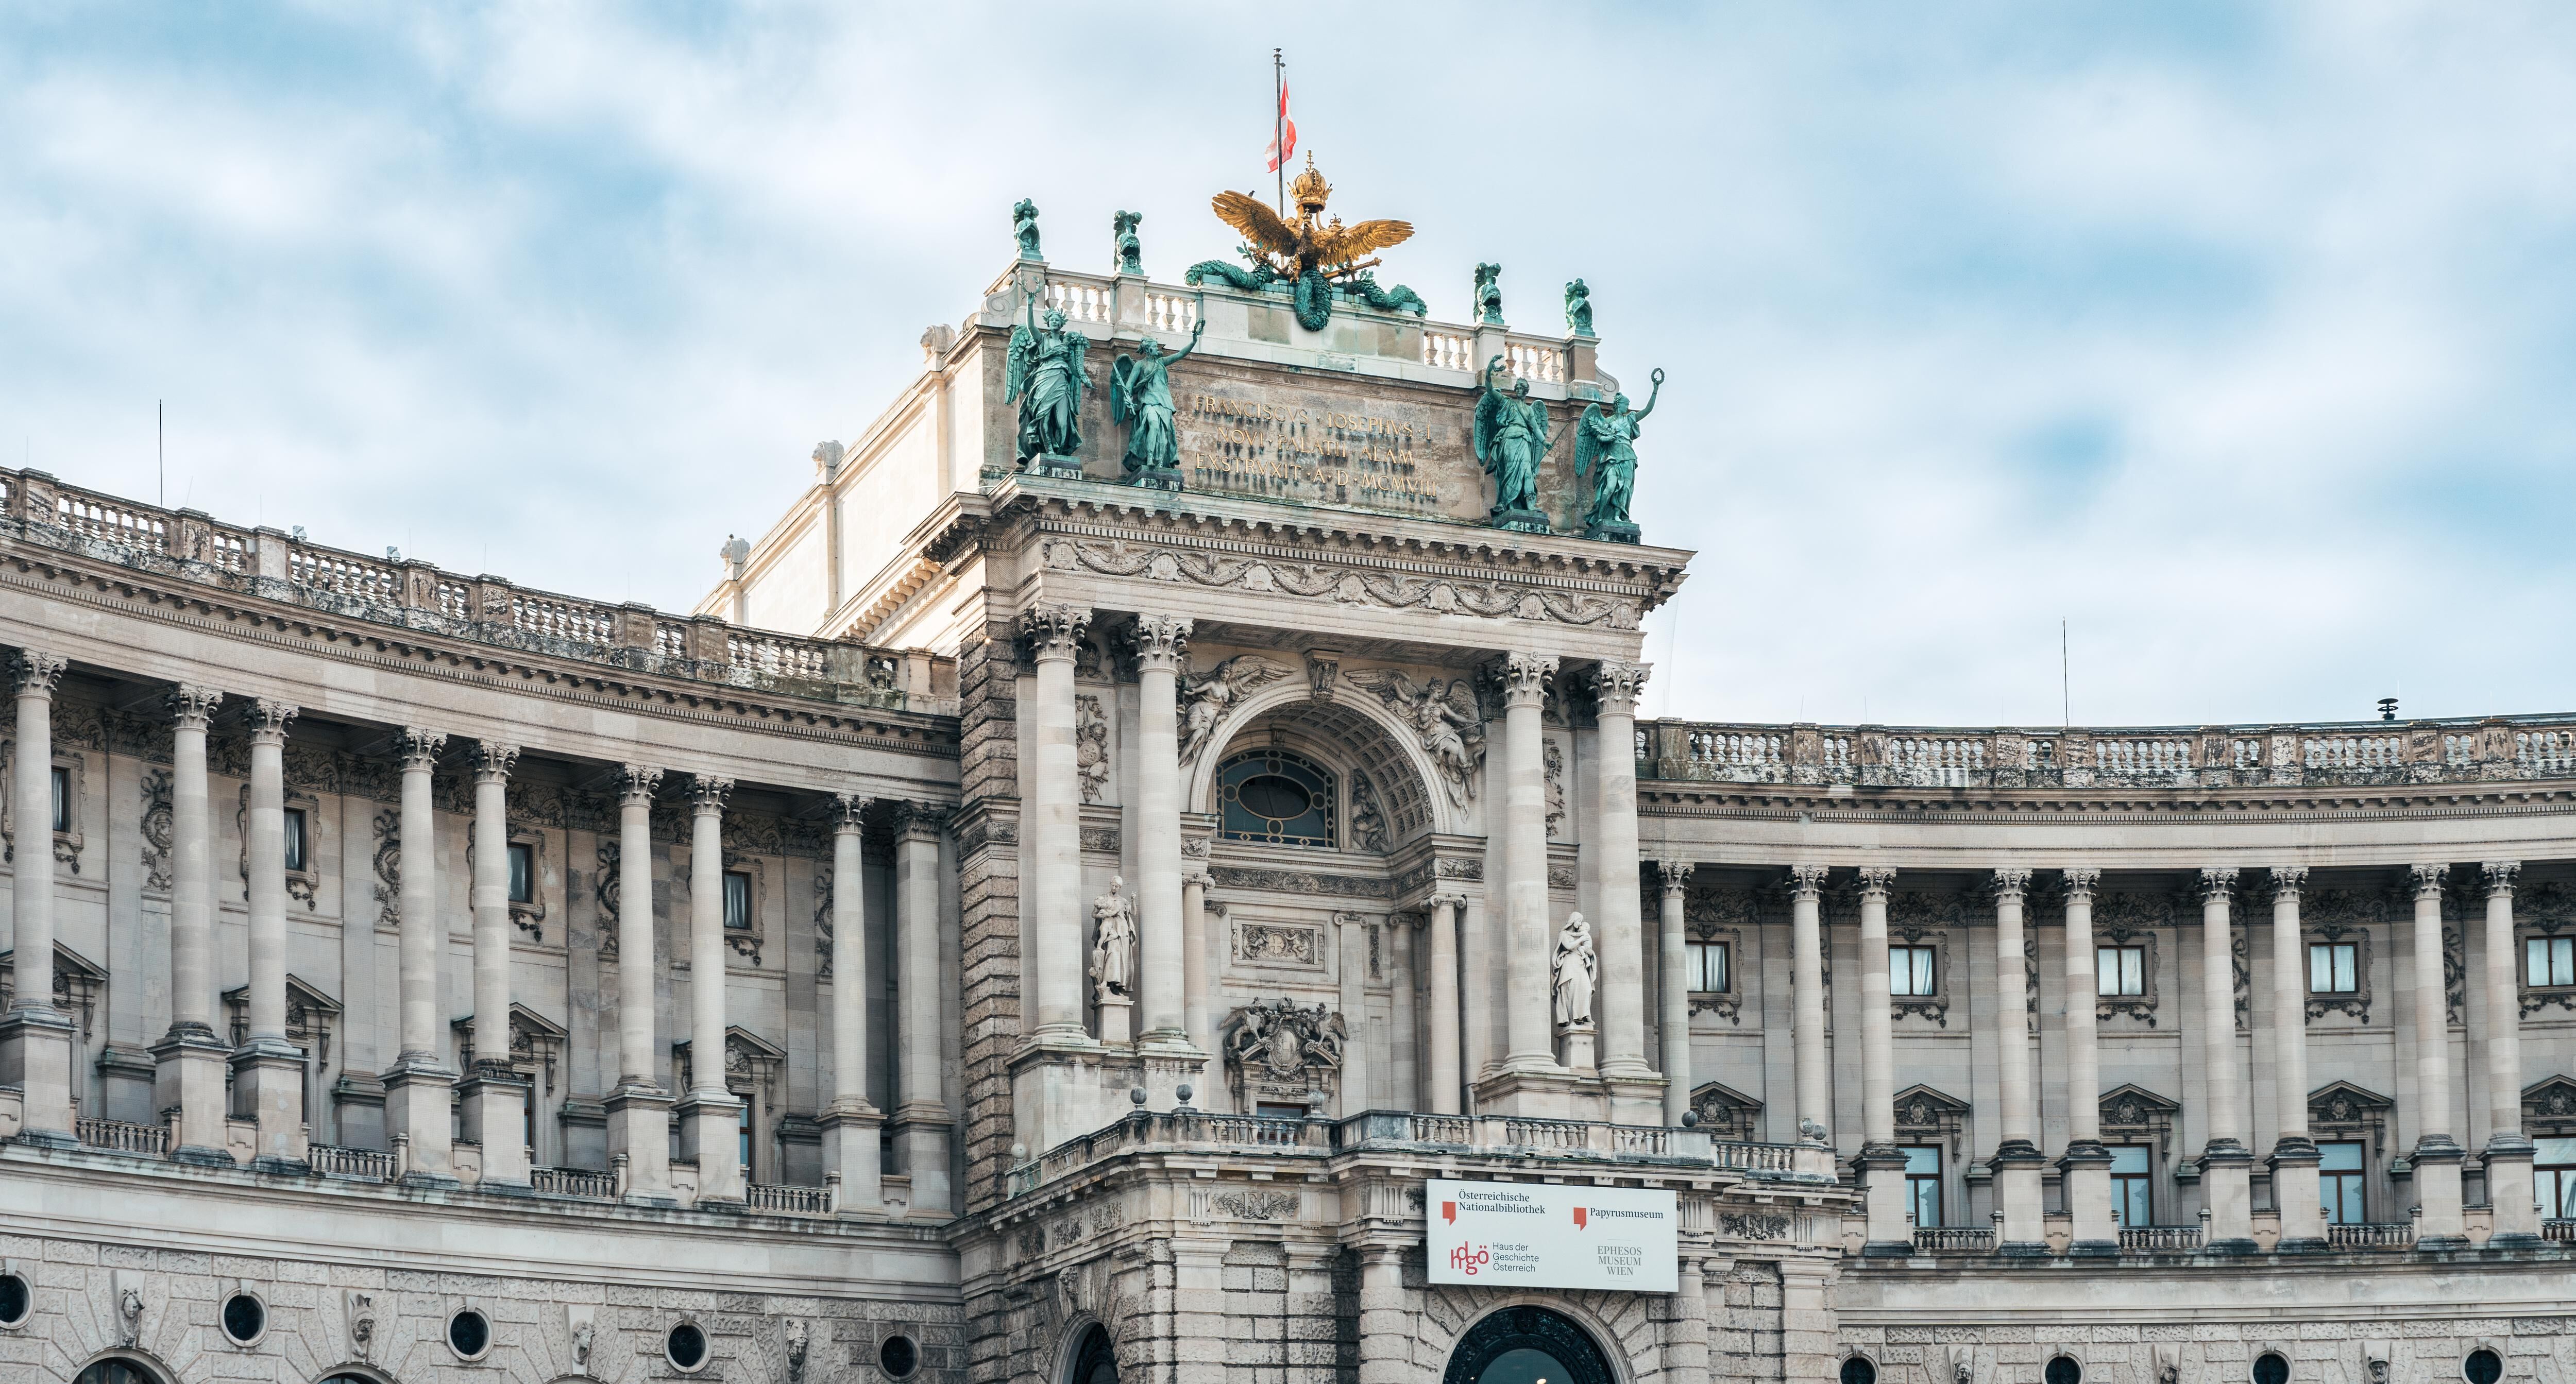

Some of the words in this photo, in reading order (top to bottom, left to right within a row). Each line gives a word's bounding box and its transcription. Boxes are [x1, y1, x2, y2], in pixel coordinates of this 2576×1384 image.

[1195, 395, 1308, 424] FRANCISCVS
[1328, 412, 1413, 437] IOSEPHVS
[1217, 427, 1264, 448] NOVI
[1278, 434, 1347, 457] PALATII
[1360, 445, 1414, 466] ALAM
[1196, 453, 1302, 480] EXSTRVXIT
[1313, 468, 1326, 483] A
[1336, 469, 1349, 486] D
[1361, 473, 1437, 498] MCMVIII
[1459, 1189, 1530, 1202] Österreichische
[1459, 1202, 1546, 1214] Nationalbibliothek
[1590, 1207, 1664, 1219] Papyrusmuseum
[1493, 1242, 1513, 1251] Haus
[1515, 1242, 1529, 1251] der
[1597, 1245, 1642, 1256] EPHESOS
[1493, 1252, 1539, 1262] Geschichte
[1598, 1256, 1641, 1266] MUSEUM
[1493, 1261, 1536, 1272] Österreich
[1606, 1267, 1634, 1276] WIEN
